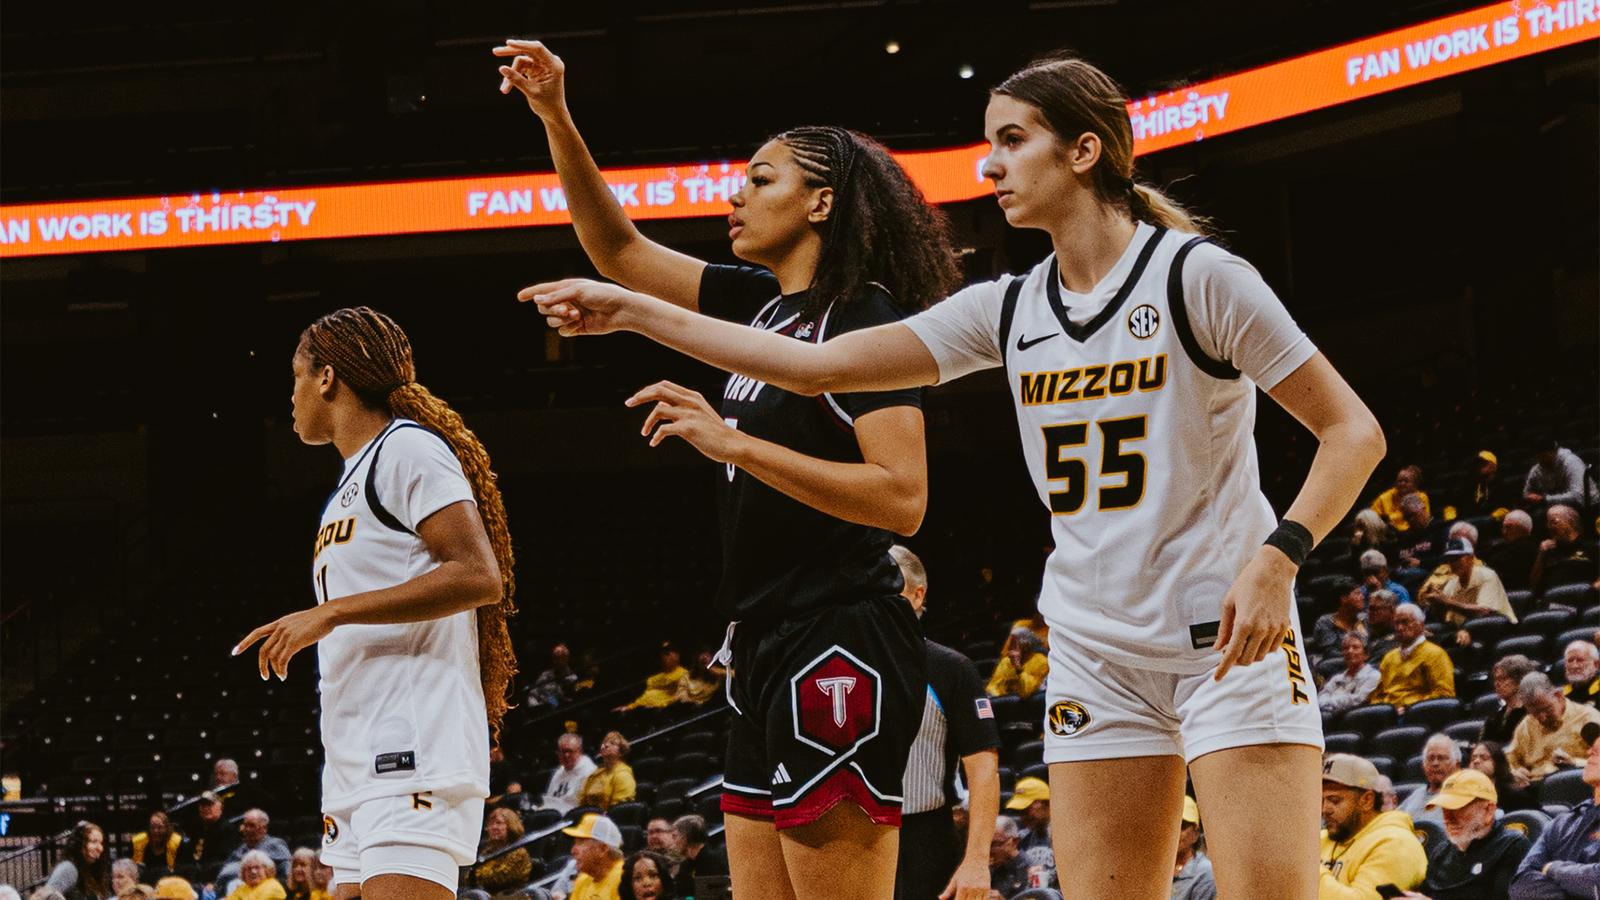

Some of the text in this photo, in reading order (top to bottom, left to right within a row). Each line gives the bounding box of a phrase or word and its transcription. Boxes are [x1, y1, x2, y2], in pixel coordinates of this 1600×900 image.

[1347, 47, 1400, 86] FAN
[1405, 23, 1490, 70] WORK
[1494, 15, 1520, 48] IS
[37, 211, 133, 242] WORK
[140, 209, 168, 236] IS
[175, 200, 317, 233] THIRSTY
[468, 189, 533, 216] FAN
[539, 181, 639, 213] WK
[646, 181, 676, 207] IS
[1128, 304, 1160, 339] SEC
[1019, 353, 1168, 407] MIZZOU
[1041, 414, 1148, 517] 55
